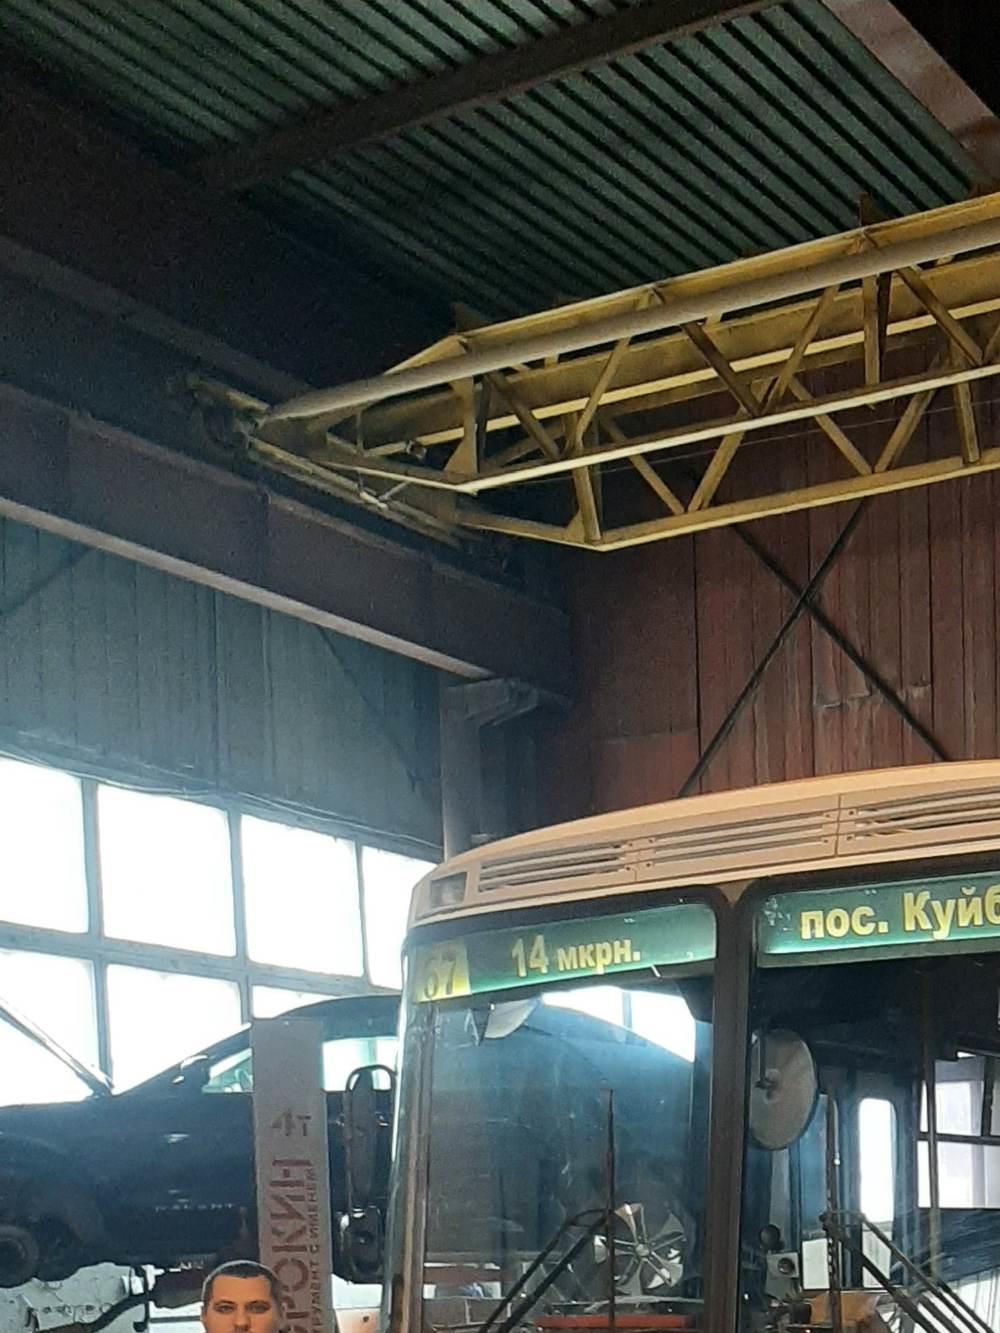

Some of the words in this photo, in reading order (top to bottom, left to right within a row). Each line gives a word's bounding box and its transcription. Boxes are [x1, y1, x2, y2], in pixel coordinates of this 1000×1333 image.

[800, 906, 889, 941] пос.
[511, 934, 549, 978] 14
[556, 938, 641, 975] мкрн.
